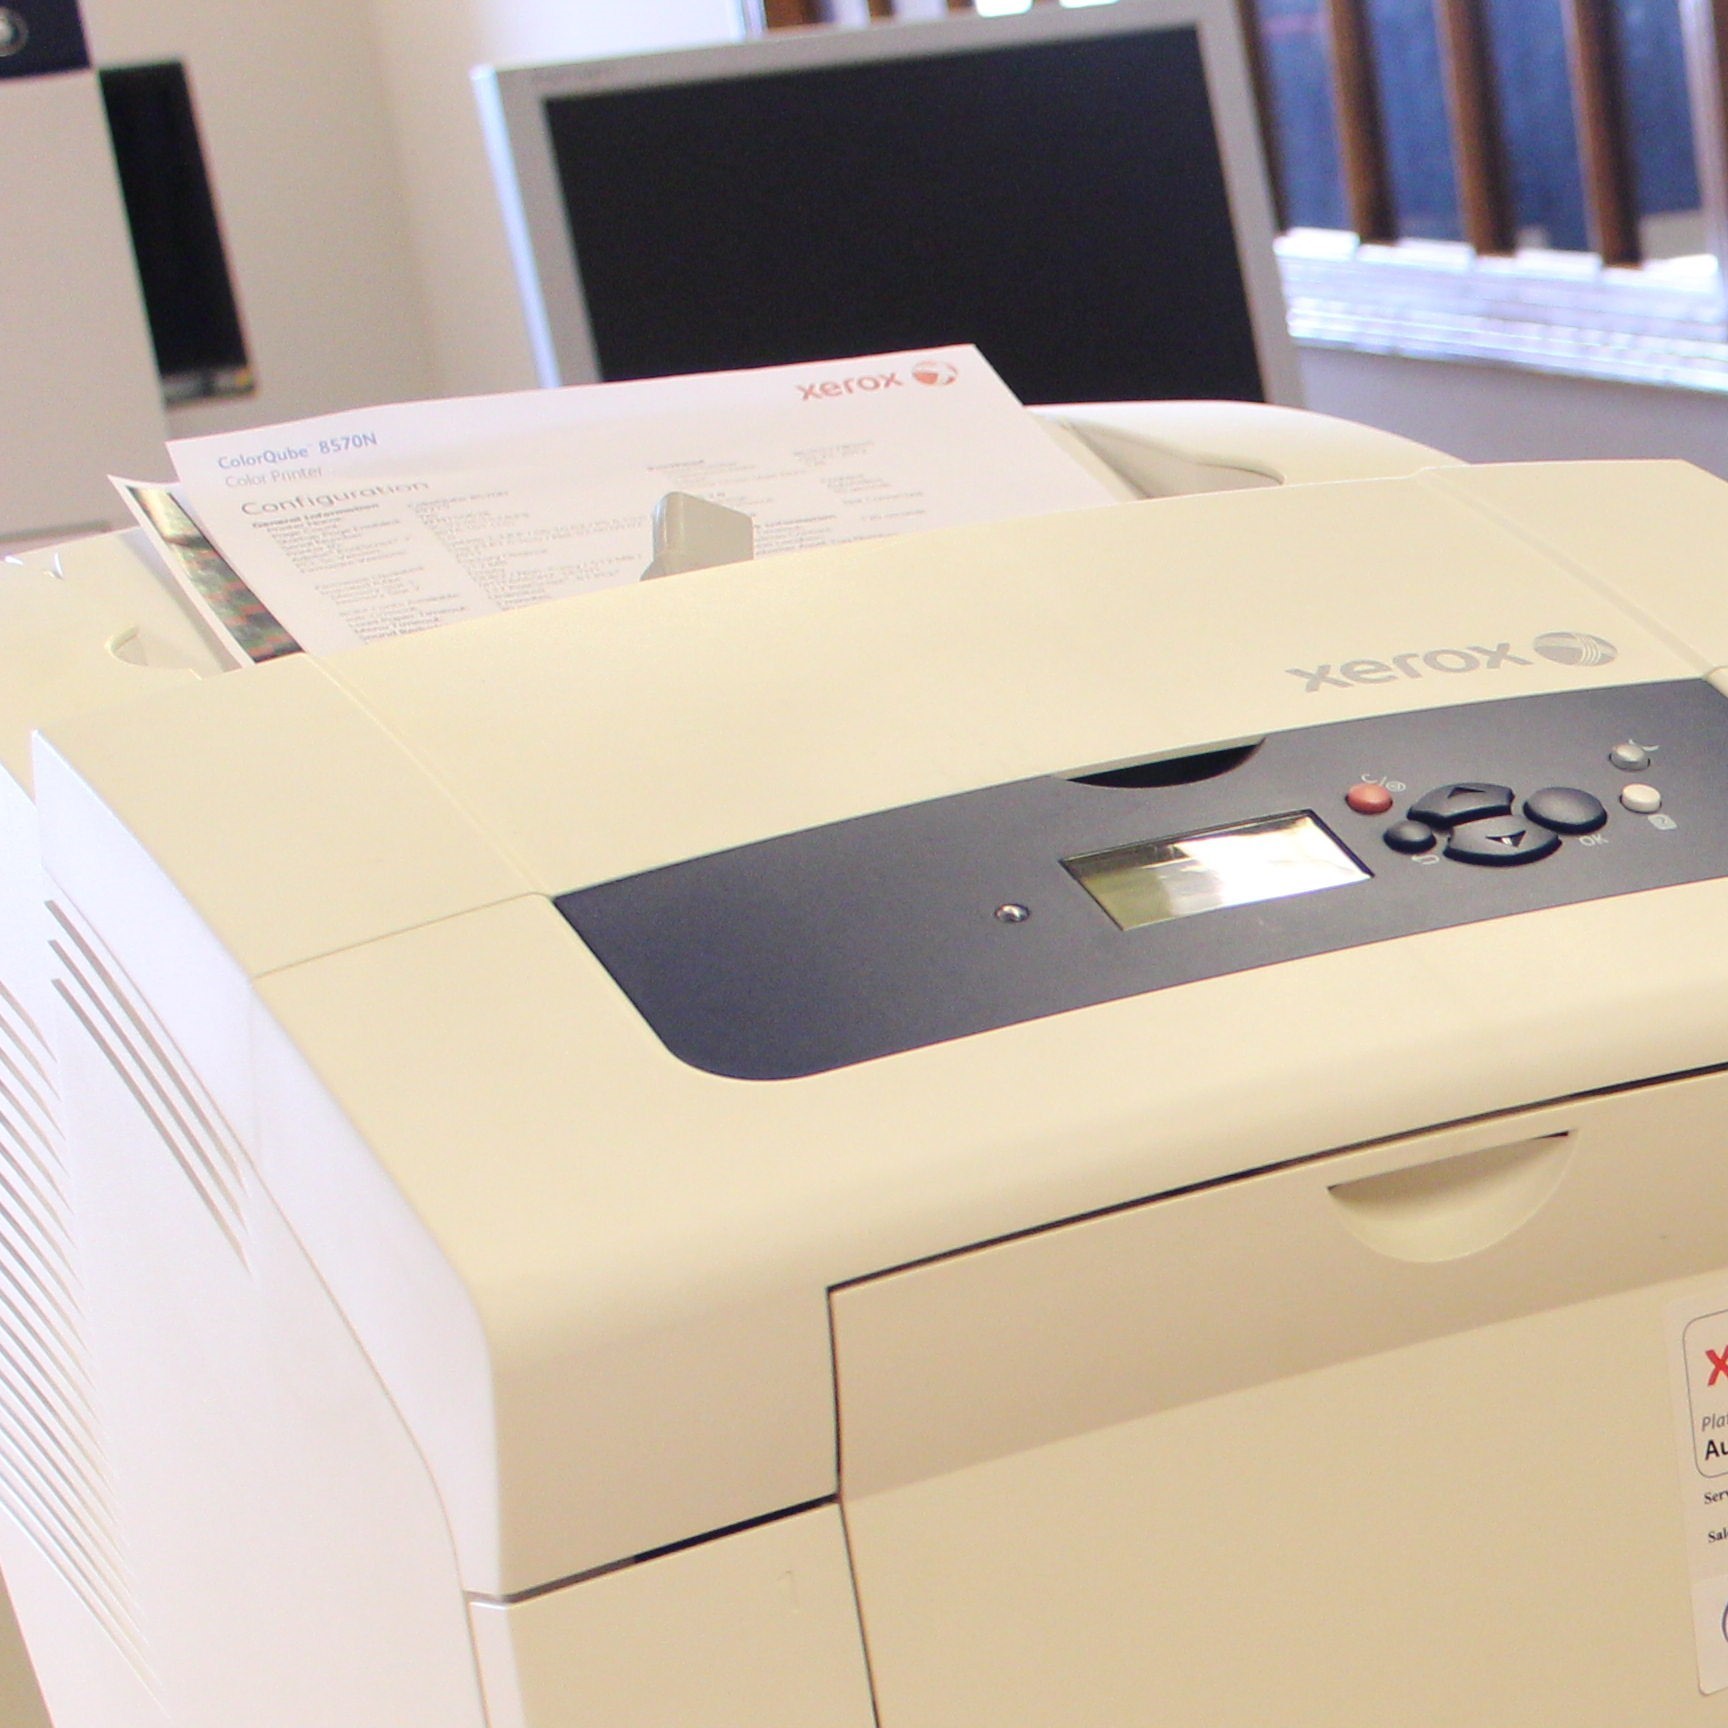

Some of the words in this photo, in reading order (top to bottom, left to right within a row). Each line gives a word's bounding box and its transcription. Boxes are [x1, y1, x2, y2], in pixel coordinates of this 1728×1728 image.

[795, 372, 904, 401] xerox
[319, 433, 378, 455] 8570N
[225, 472, 268, 489] Color
[271, 466, 323, 484] Printer
[241, 480, 430, 516] Configuration
[1285, 642, 1534, 693] xerox
[1579, 834, 1609, 847] OK
